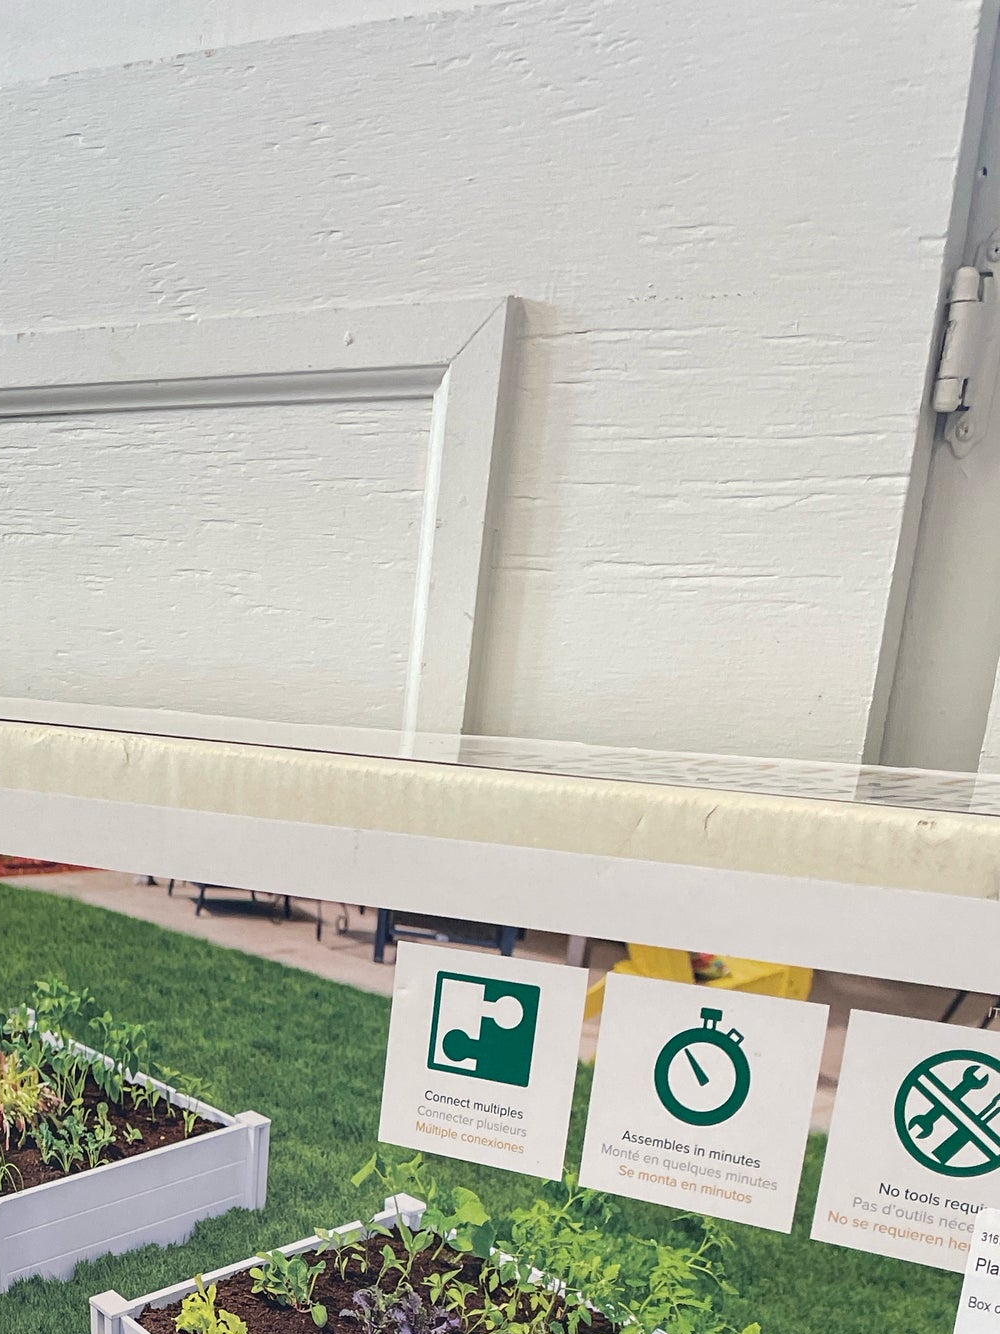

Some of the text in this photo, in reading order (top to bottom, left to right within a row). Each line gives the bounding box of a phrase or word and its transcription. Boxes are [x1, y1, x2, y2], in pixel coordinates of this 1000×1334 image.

[424, 1090, 524, 1120] Connect multiples
[417, 1105, 528, 1138] Connecter plusieurs
[460, 1133, 525, 1154] conexiones
[621, 1130, 761, 1169] Assembles in minutes
[601, 1143, 778, 1191] Monté en quelques minutes
[618, 1164, 753, 1204] Se monta en minutos
[878, 1182, 900, 1198] No
[904, 1188, 940, 1206] tools
[852, 1196, 877, 1212] Pas
[828, 1210, 849, 1225] No
[852, 1217, 869, 1230] se
[873, 1222, 944, 1247] requieren
[967, 1295, 991, 1312] Box
